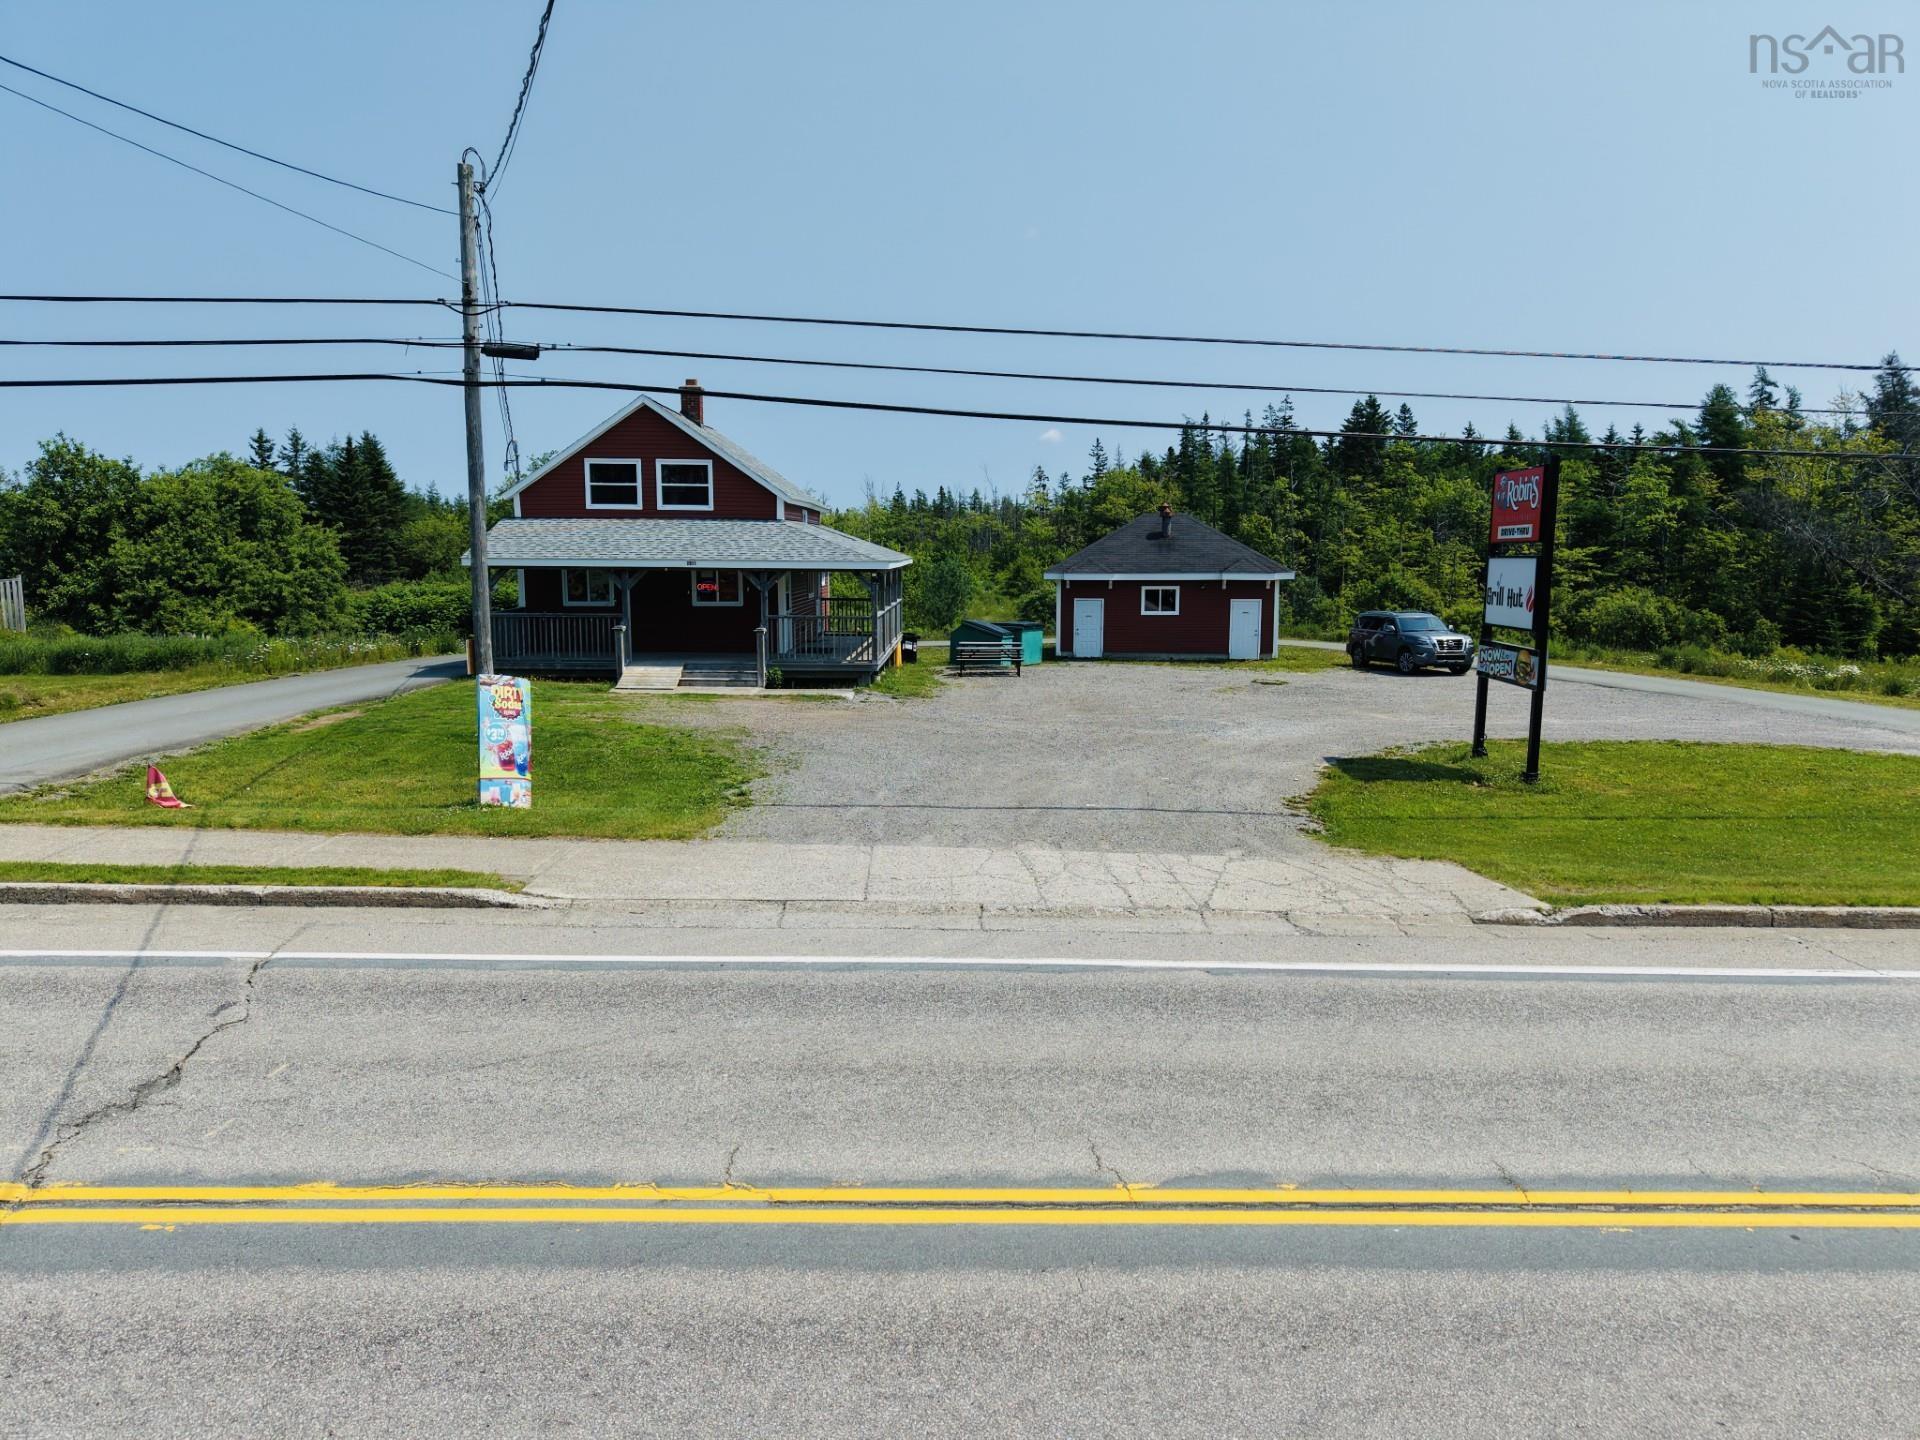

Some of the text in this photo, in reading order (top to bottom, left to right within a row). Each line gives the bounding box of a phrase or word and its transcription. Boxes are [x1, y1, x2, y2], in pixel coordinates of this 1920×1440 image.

[696, 583, 719, 592] OPEN
[1486, 582, 1524, 609] Grill Hut
[1488, 660, 1512, 676] OPEN
[490, 684, 523, 701] DIRTY
